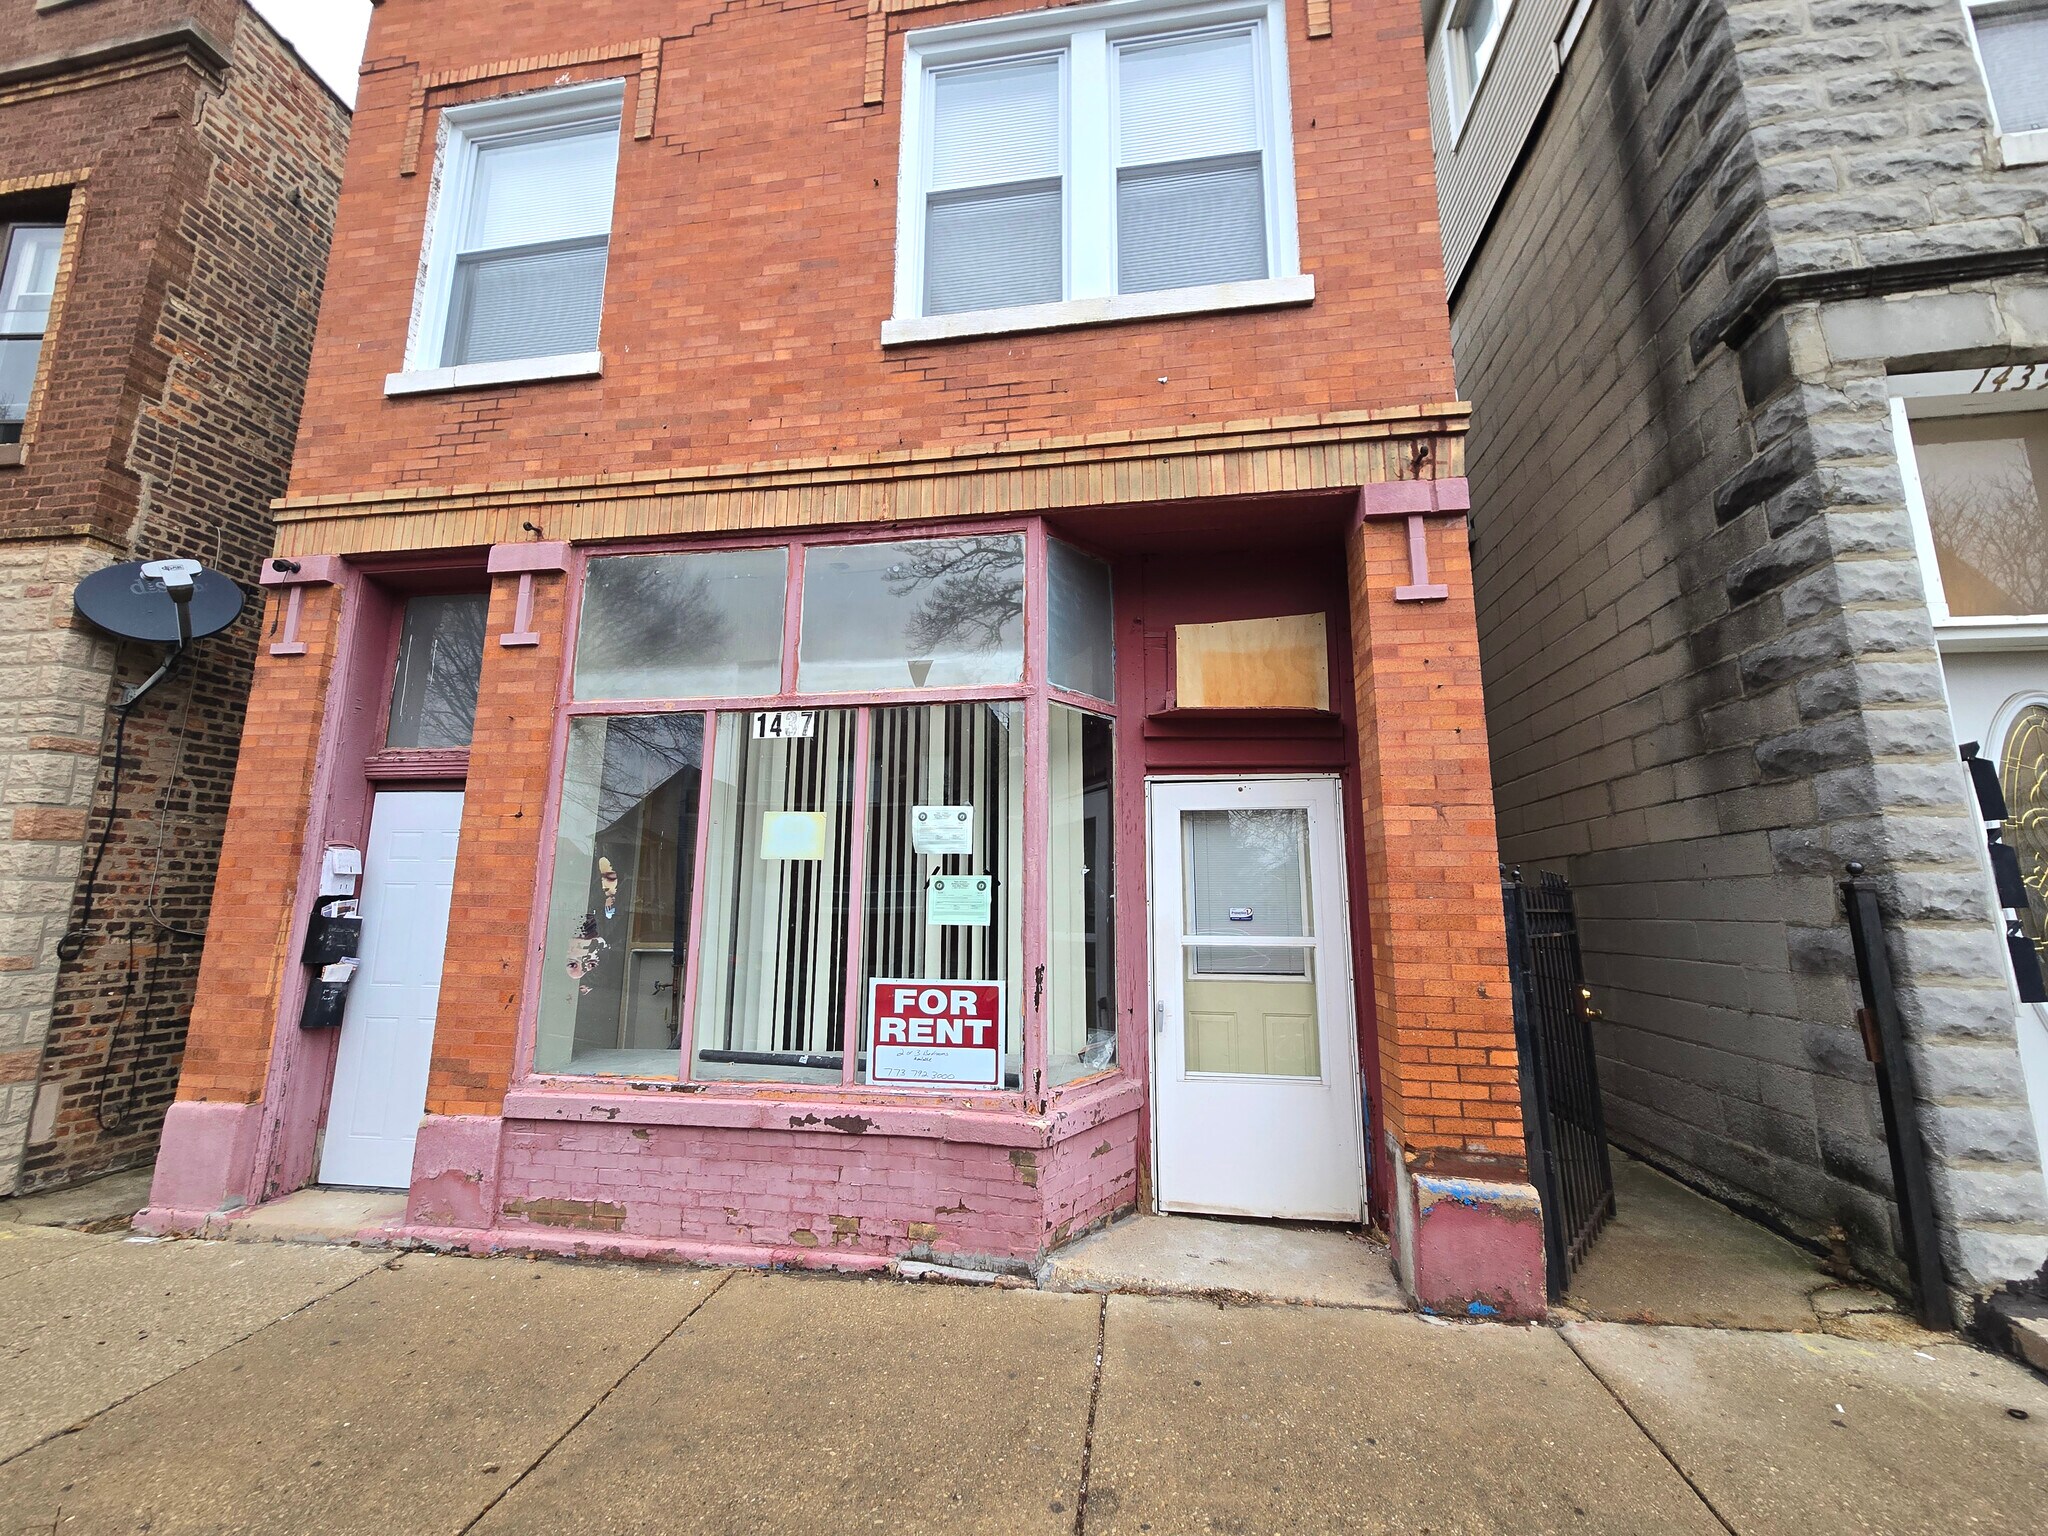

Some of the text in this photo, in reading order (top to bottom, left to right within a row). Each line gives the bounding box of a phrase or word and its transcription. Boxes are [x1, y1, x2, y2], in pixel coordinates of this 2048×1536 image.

[757, 711, 813, 738] 1437
[893, 988, 978, 1015] FOR
[879, 1017, 992, 1045] RENT
[913, 1049, 921, 1057] 3
[883, 1067, 955, 1080] 773 792 3000
